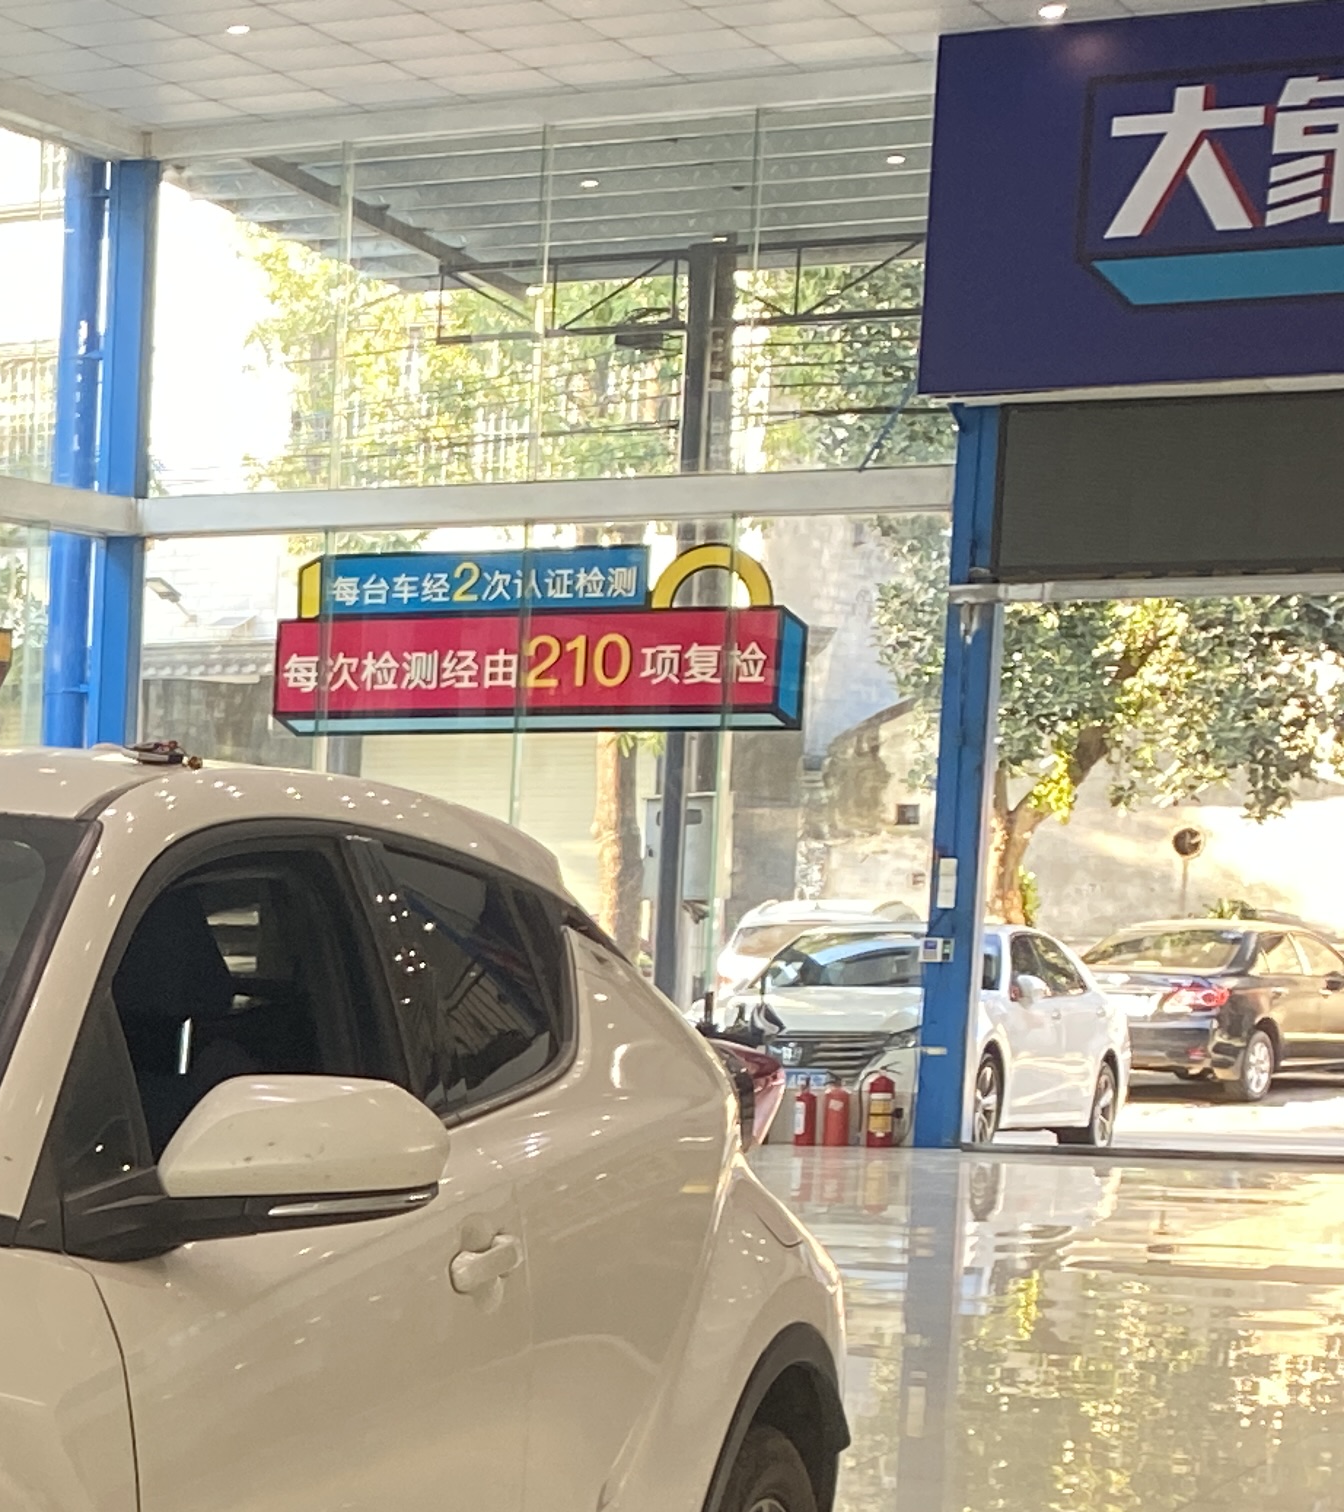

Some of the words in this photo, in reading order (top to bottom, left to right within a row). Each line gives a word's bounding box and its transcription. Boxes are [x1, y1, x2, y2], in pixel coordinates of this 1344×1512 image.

[332, 562, 638, 608] 每台车经2次认证检测
